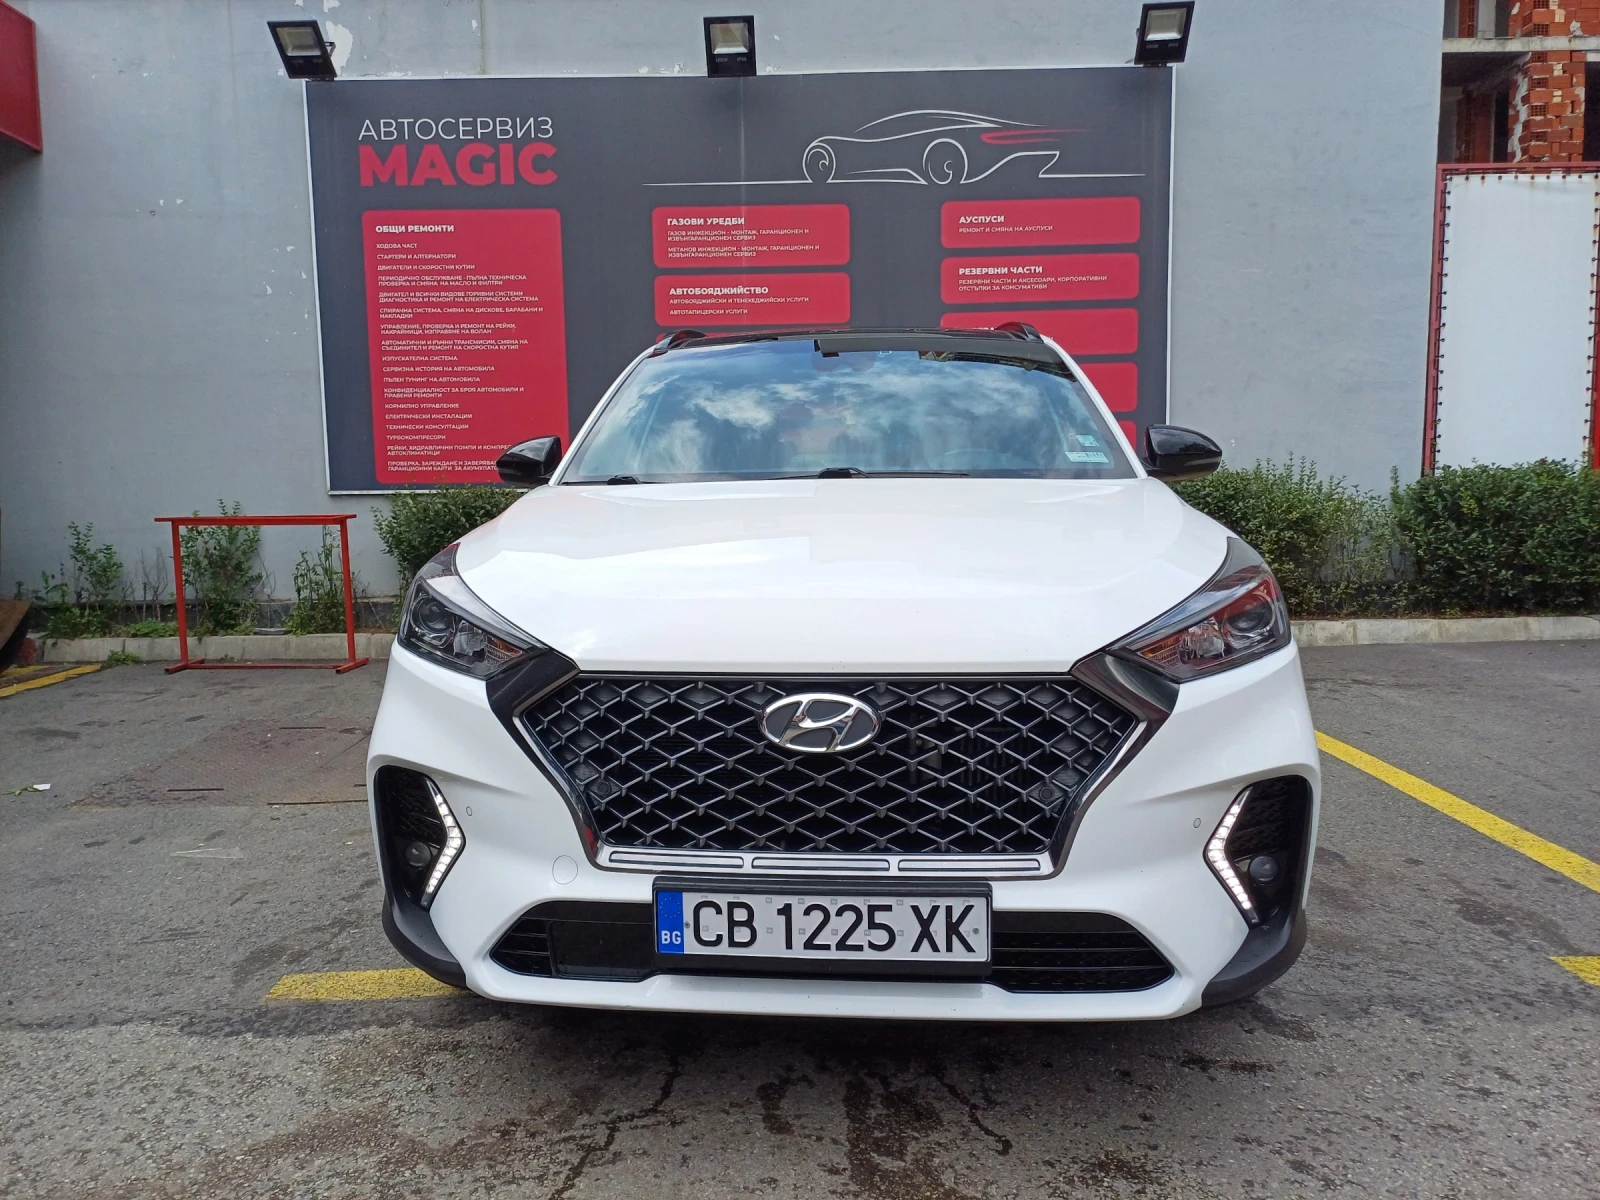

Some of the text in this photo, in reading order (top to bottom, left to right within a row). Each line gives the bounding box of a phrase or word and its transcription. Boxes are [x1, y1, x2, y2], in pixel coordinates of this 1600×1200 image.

[358, 116, 554, 141] АВТОСЕРВИЗ
[358, 141, 559, 187] MAGIC
[706, 218, 744, 226] УРЕДБИ
[959, 215, 1005, 223] АУСПУСИ
[376, 225, 405, 233] ОБЩИ
[959, 266, 1042, 275] РЕЗЕРВНИ ЧАСТИ
[670, 286, 768, 295] АВТОБОЯДЖИЙСТВО
[776, 902, 897, 952] 1225
[661, 930, 682, 946] BG
